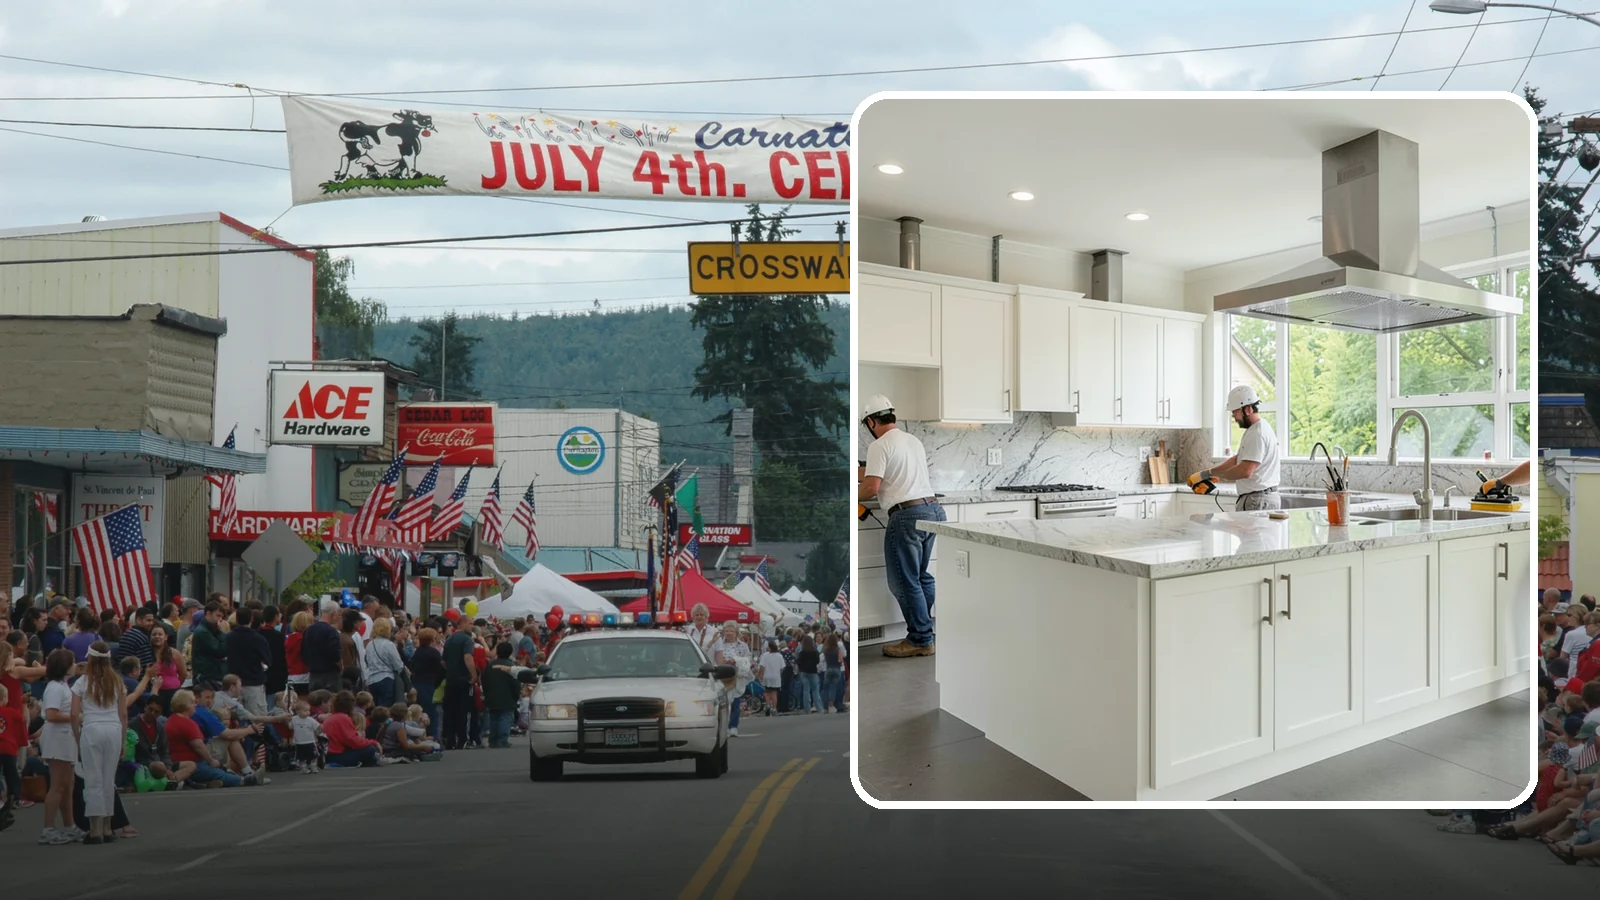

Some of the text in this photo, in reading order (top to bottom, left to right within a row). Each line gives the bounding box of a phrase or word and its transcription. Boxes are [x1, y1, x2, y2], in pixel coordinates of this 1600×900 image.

[481, 141, 604, 193] JULY
[632, 150, 746, 197] 4th.
[697, 254, 850, 280] CROSSWA
[283, 380, 373, 420] ACE
[405, 409, 485, 422] CEDAR LOG
[283, 421, 371, 436] Hardware
[416, 428, 477, 447] Coca-Cola
[95, 485, 124, 494] Vincent
[126, 486, 136, 494] de
[138, 486, 155, 495] Paul
[688, 526, 741, 535] CRNATION
[699, 535, 730, 543] GLASS
